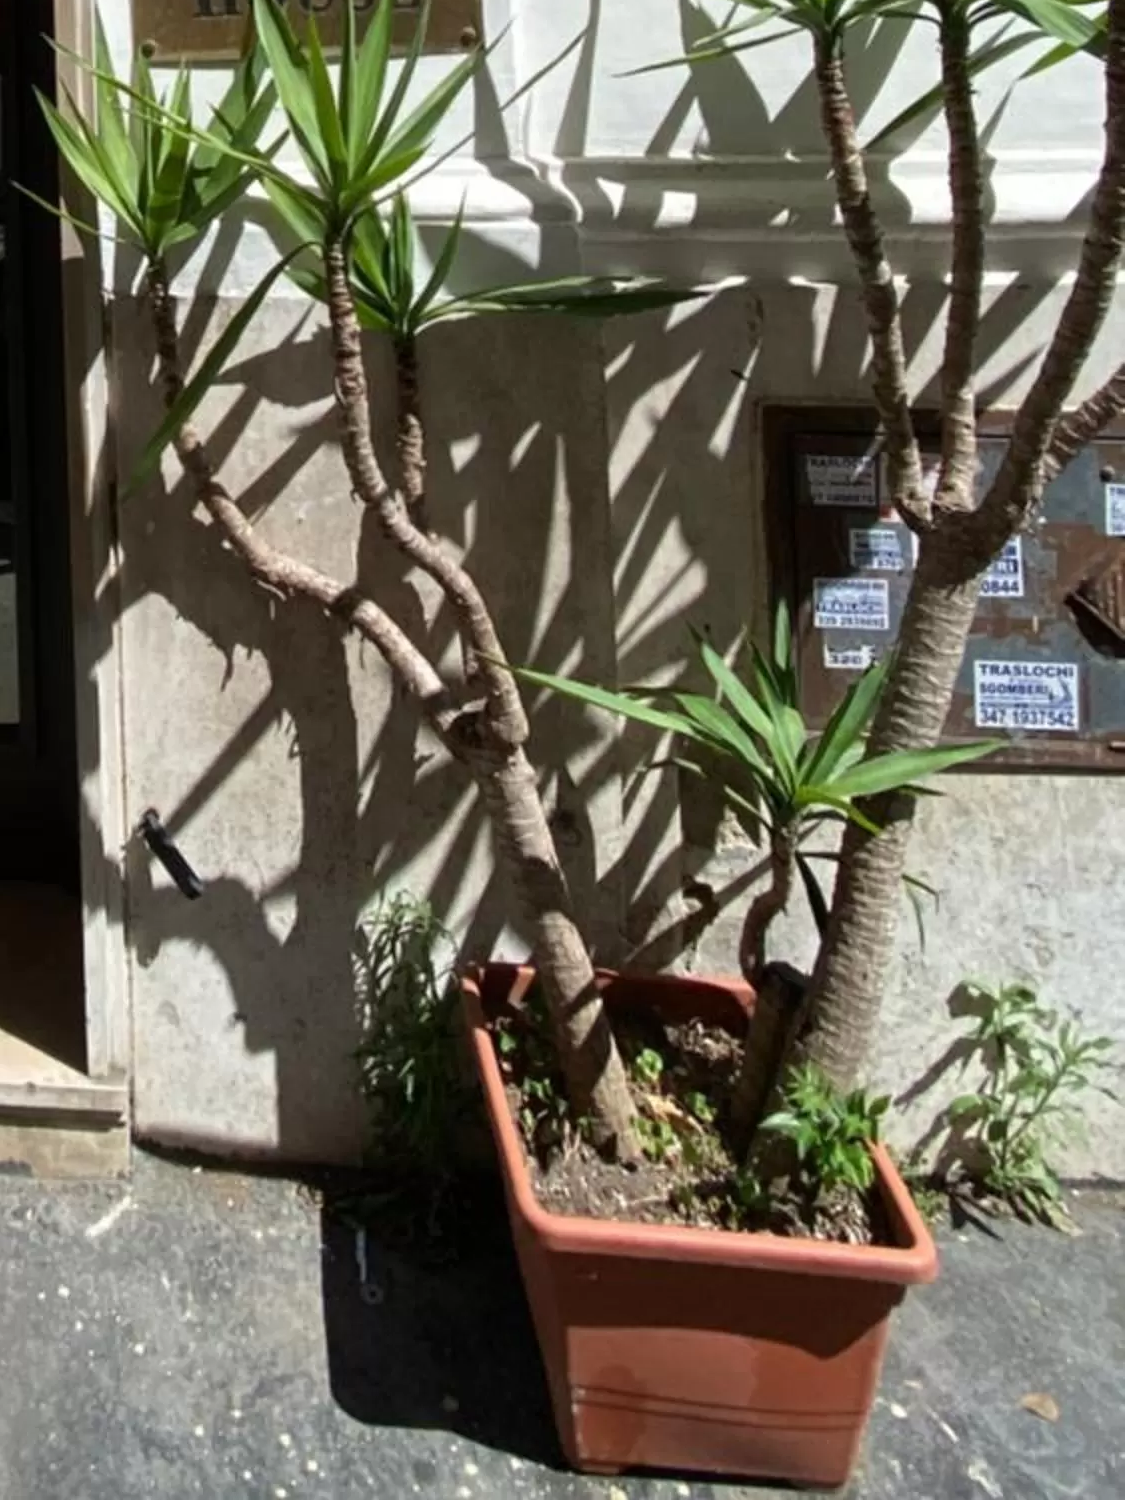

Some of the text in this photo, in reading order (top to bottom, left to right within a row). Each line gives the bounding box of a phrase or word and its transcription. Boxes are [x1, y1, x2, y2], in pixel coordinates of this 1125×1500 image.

[979, 664, 1074, 678] TRASLOCHI
[979, 683, 1049, 695] SGOMBERI
[979, 707, 1007, 724] 347
